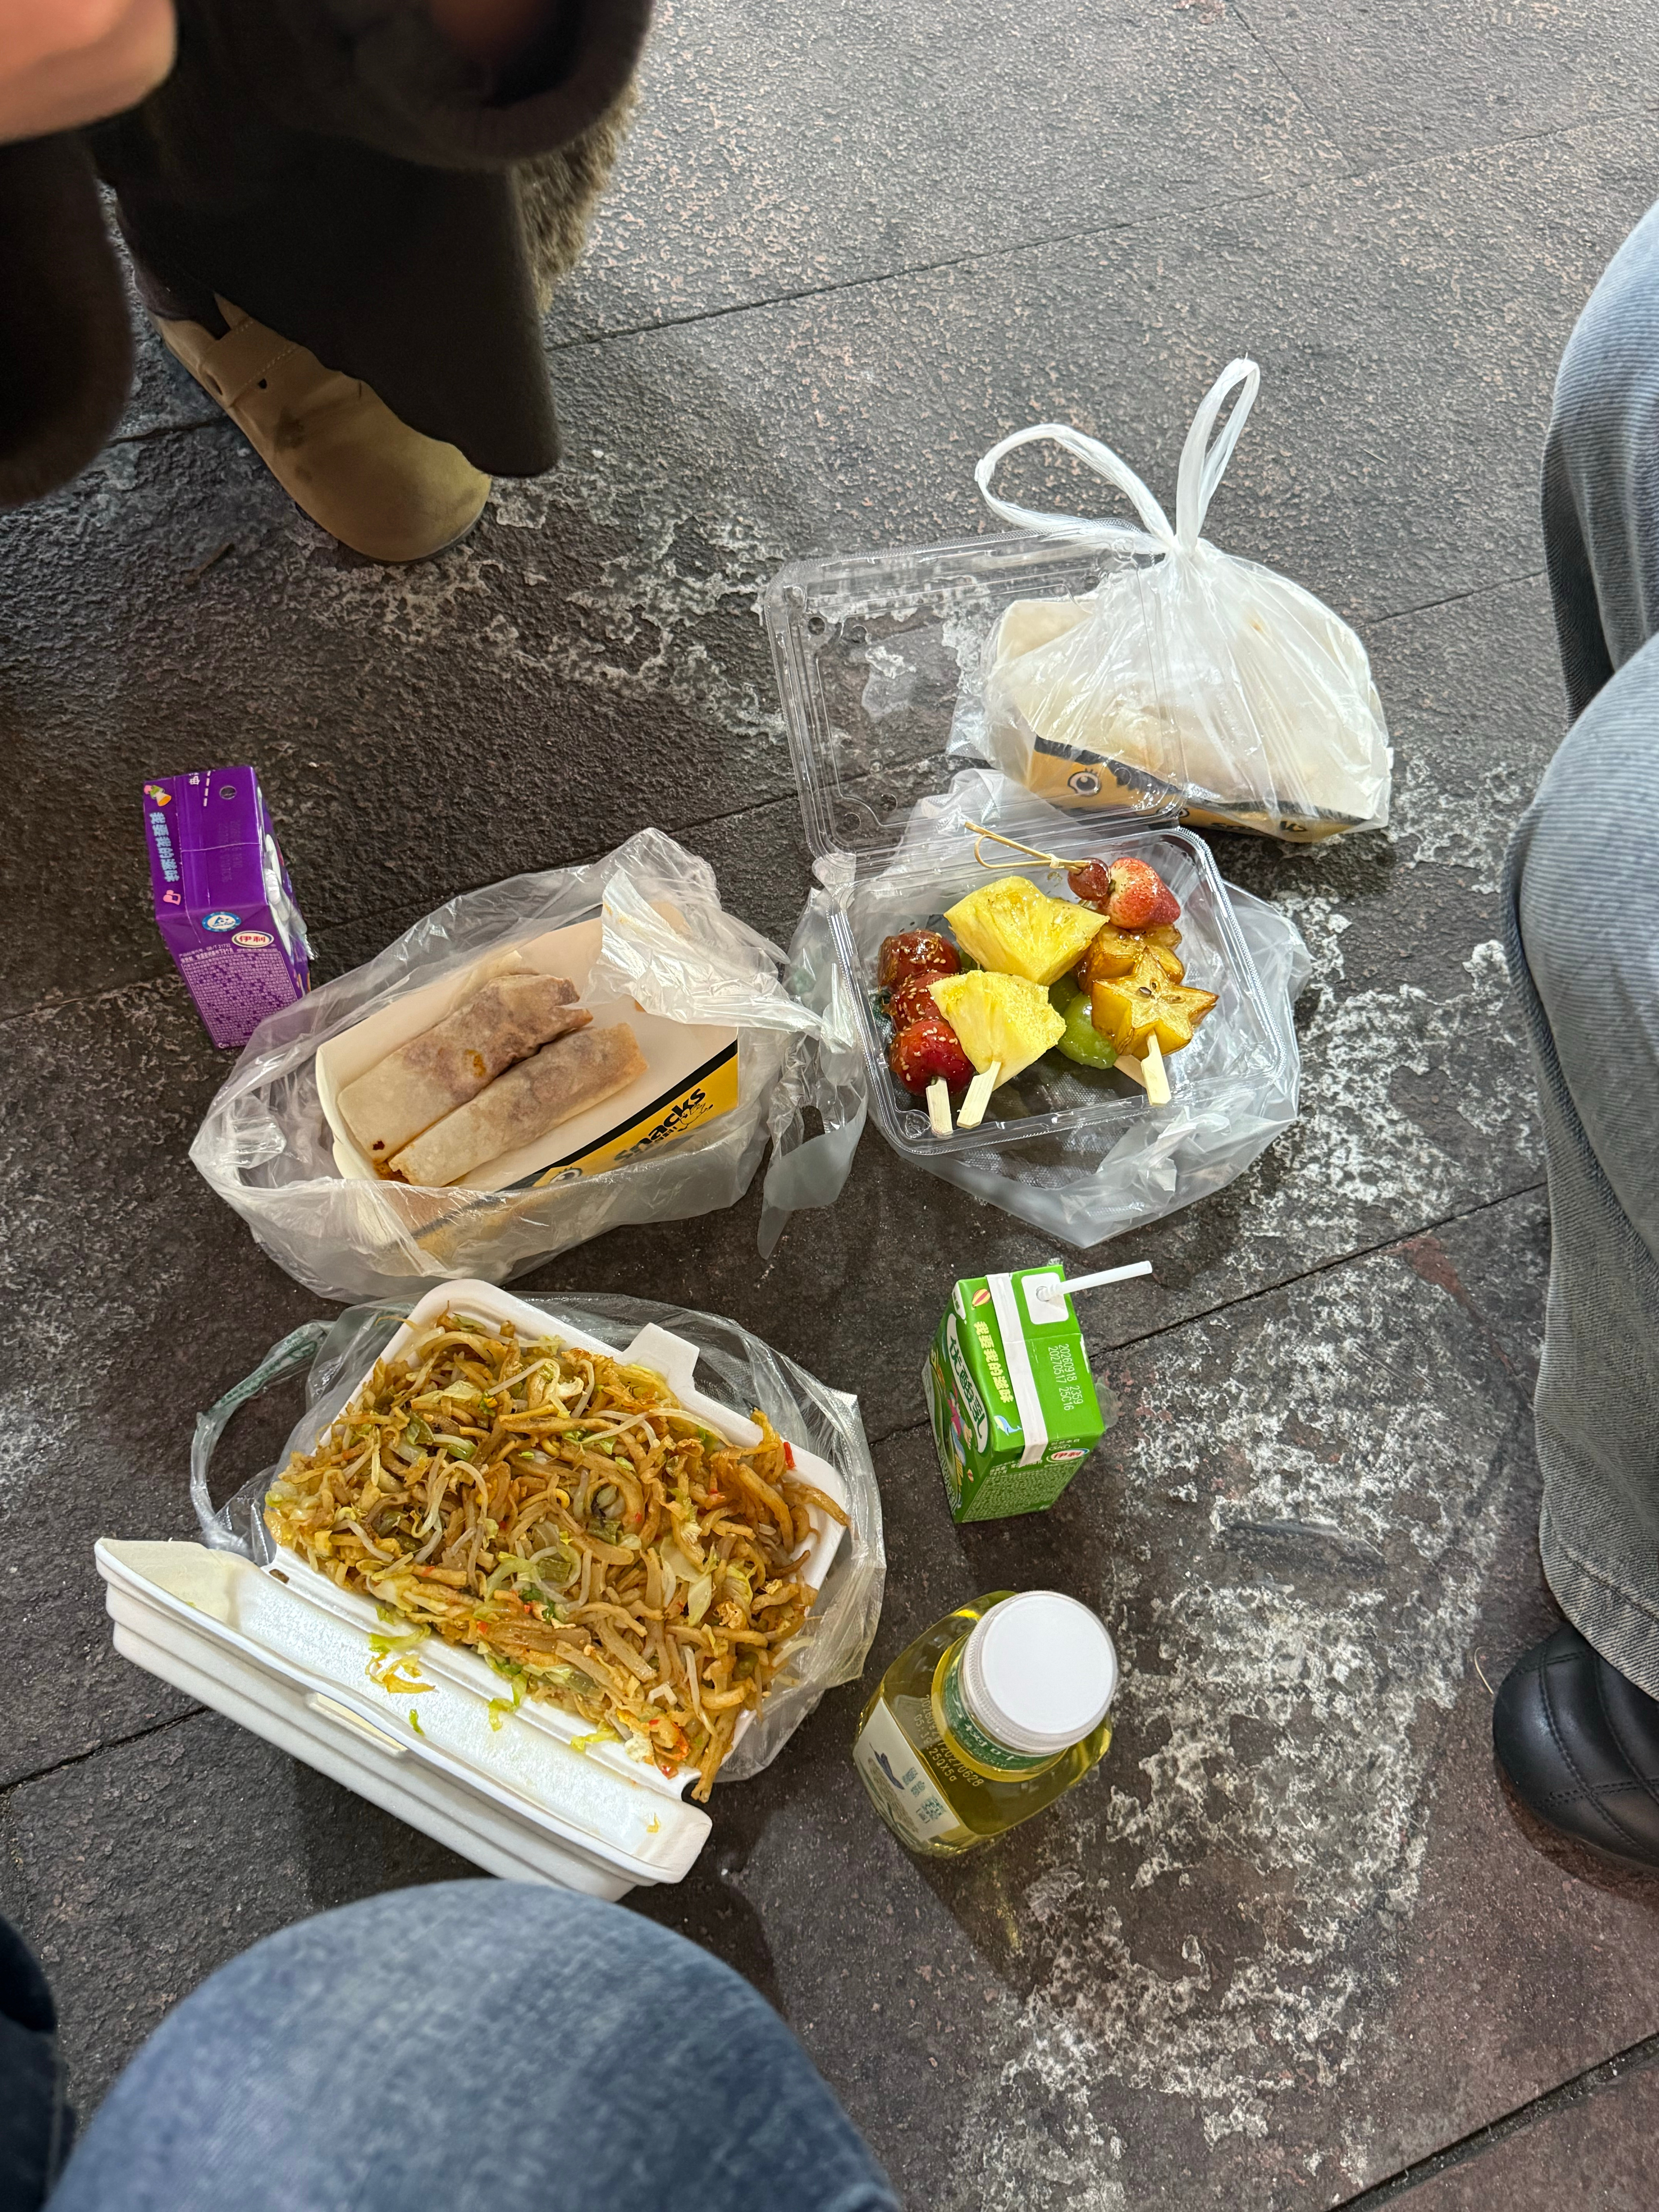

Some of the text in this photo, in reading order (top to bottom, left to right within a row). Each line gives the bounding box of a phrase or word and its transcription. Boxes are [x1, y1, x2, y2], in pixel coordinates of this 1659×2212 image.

[149, 811, 180, 883] 我要我的滋味
[950, 1335, 984, 1438] 优酸乳
[973, 1320, 1014, 1404] 我要我的滋味
[1048, 1346, 1074, 1411] 20270517 25C16
[1058, 1343, 1084, 1405] 20260918 2359
